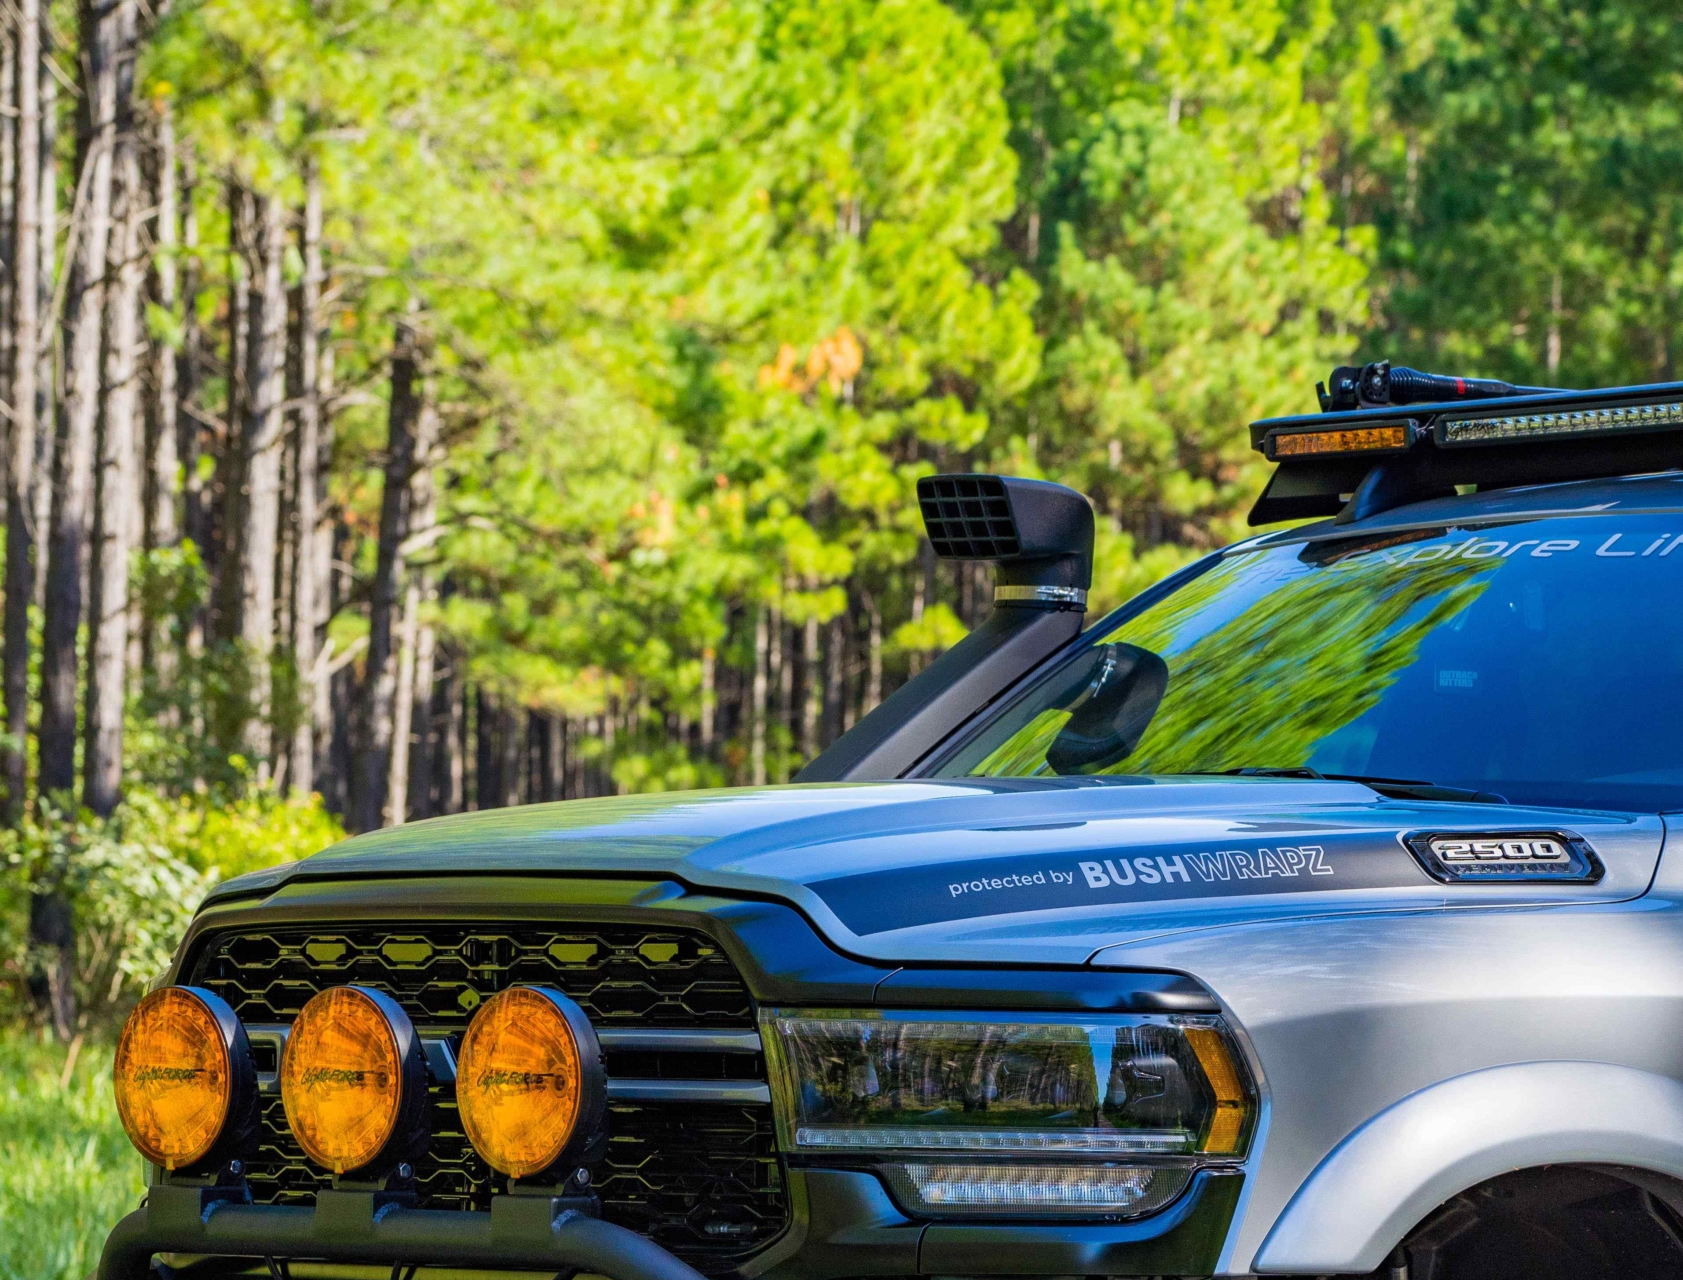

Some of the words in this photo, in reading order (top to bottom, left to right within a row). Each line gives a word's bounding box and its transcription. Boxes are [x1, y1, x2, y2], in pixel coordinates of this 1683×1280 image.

[1439, 670, 1478, 680] OUTBACK
[1439, 679, 1474, 688] KITTERS
[1438, 841, 1562, 861] 2500
[948, 871, 1046, 897] protected
[1048, 869, 1074, 885] by
